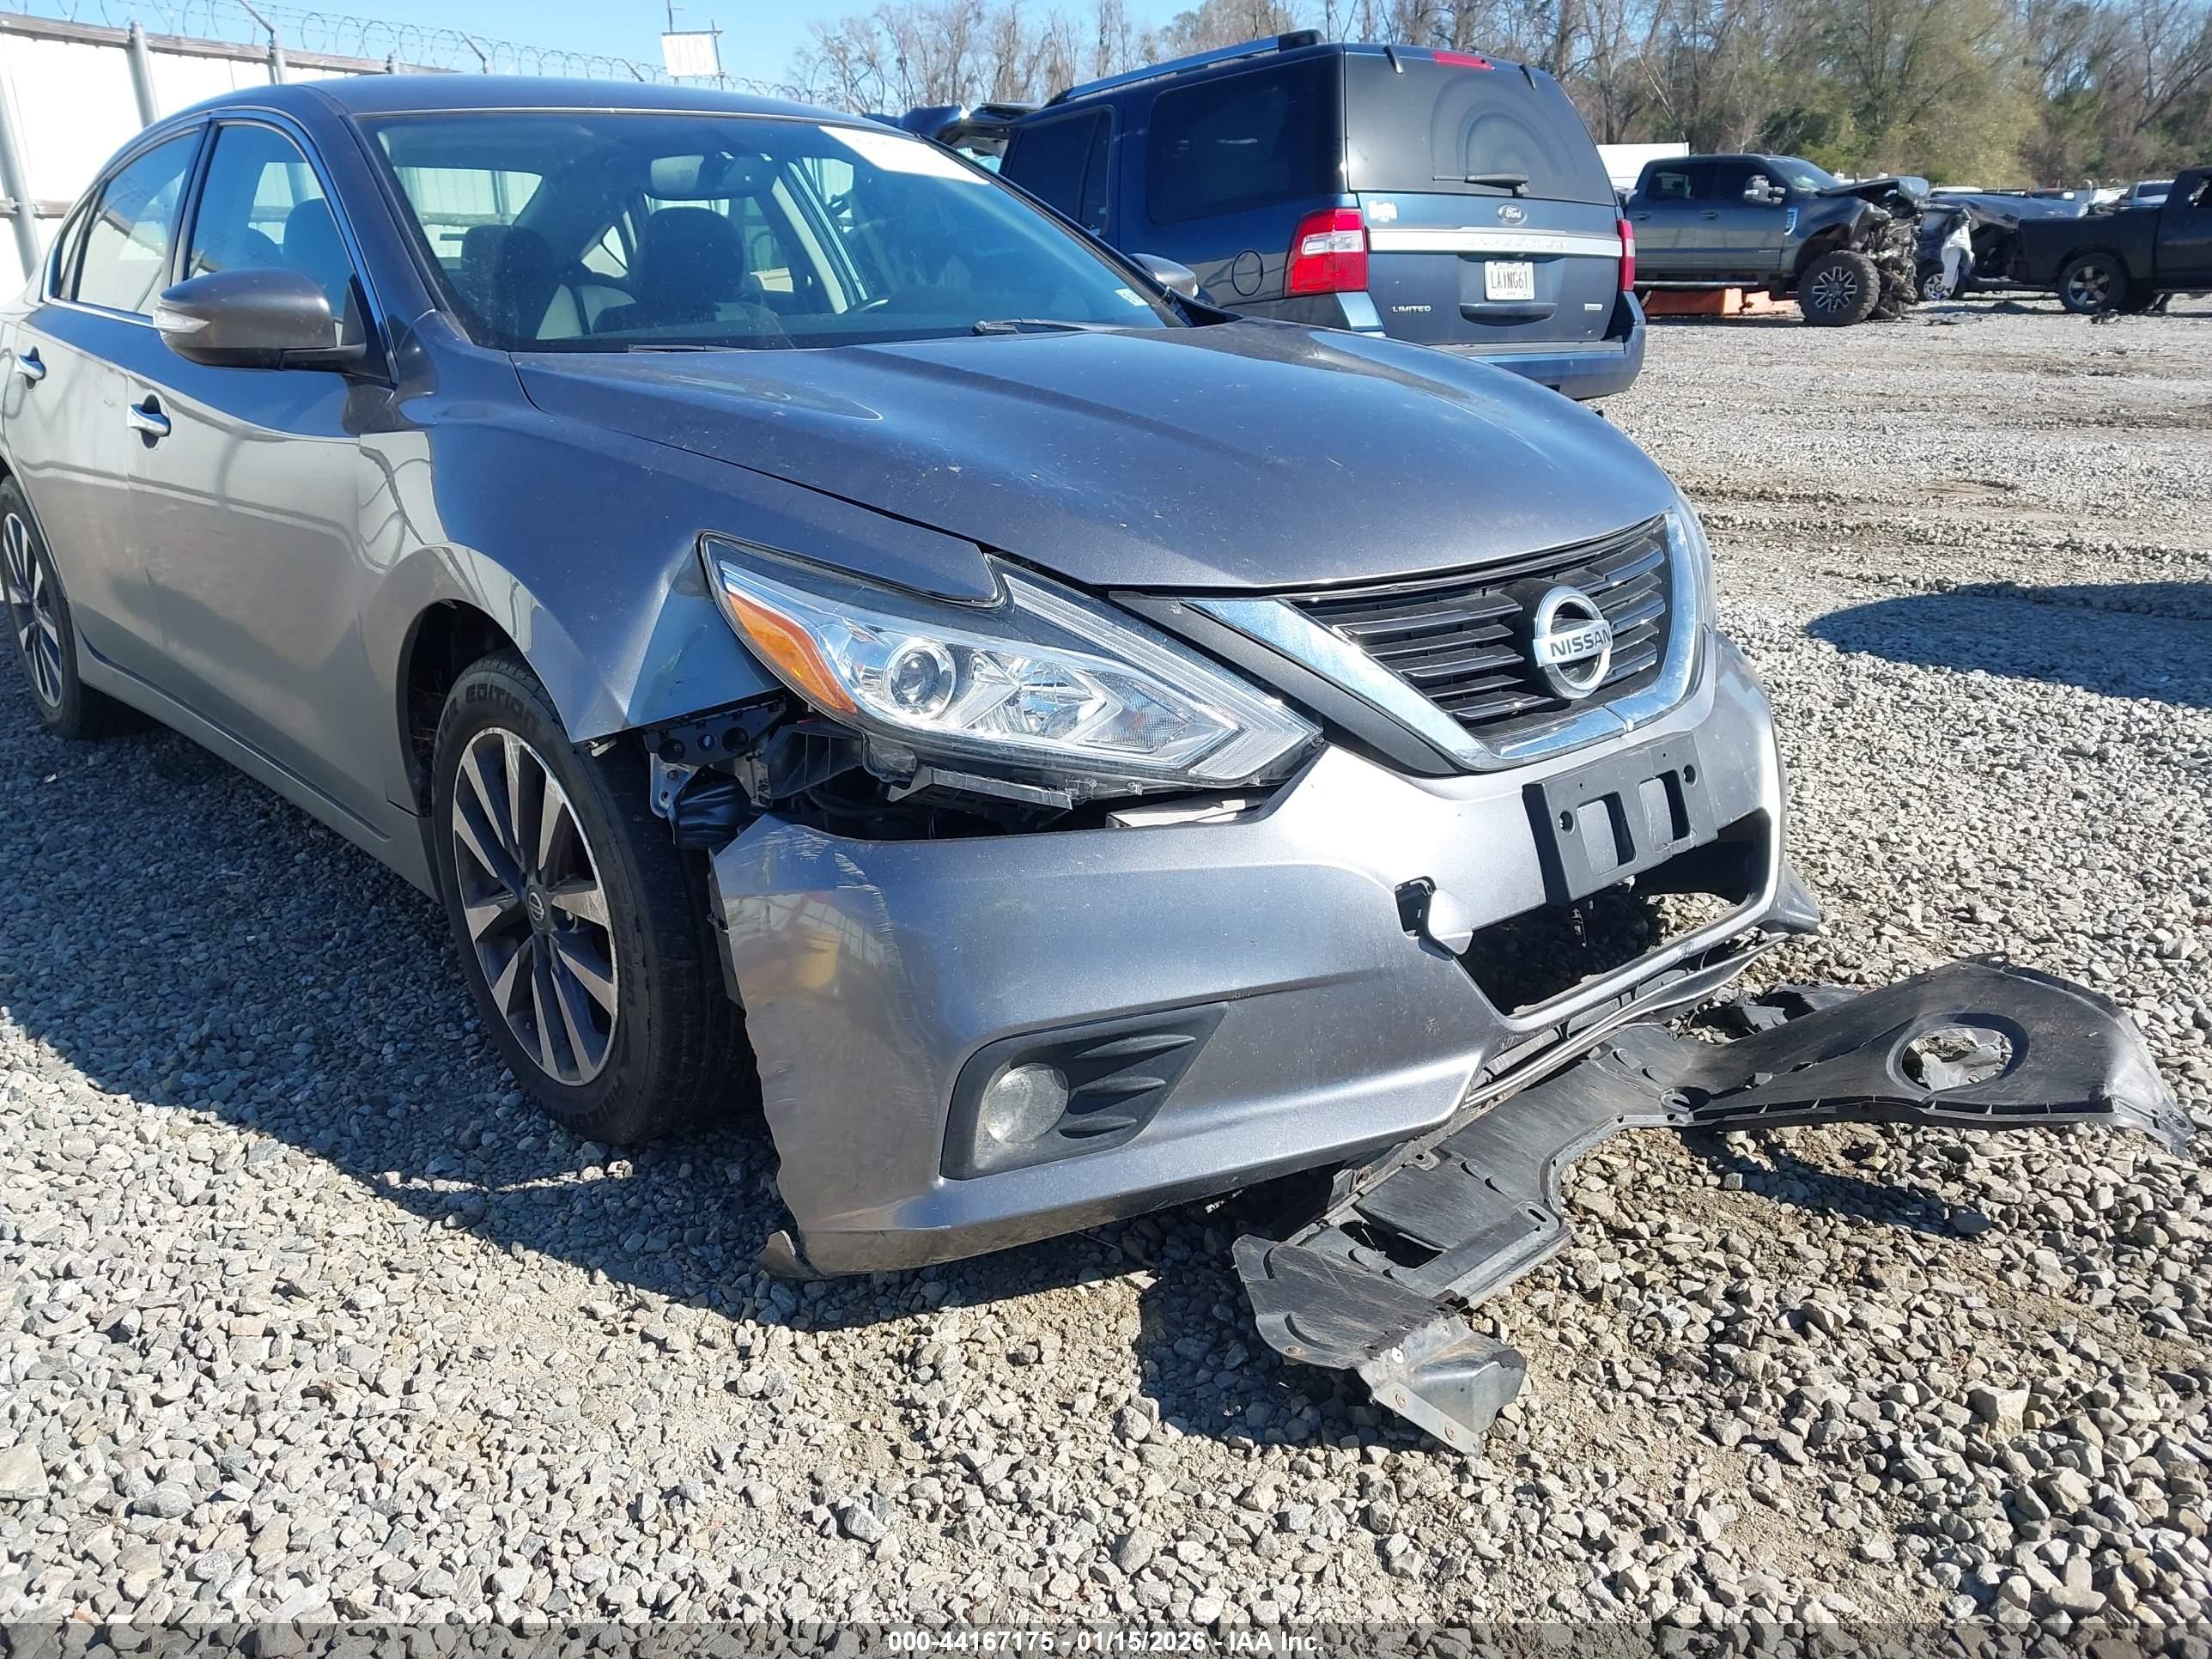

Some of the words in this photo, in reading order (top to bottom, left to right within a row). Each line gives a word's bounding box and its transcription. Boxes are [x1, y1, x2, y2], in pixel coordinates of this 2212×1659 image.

[1491, 270, 1528, 289] LAING61
[1392, 305, 1431, 313] LIMITED
[1549, 628, 1612, 658] NISSAN
